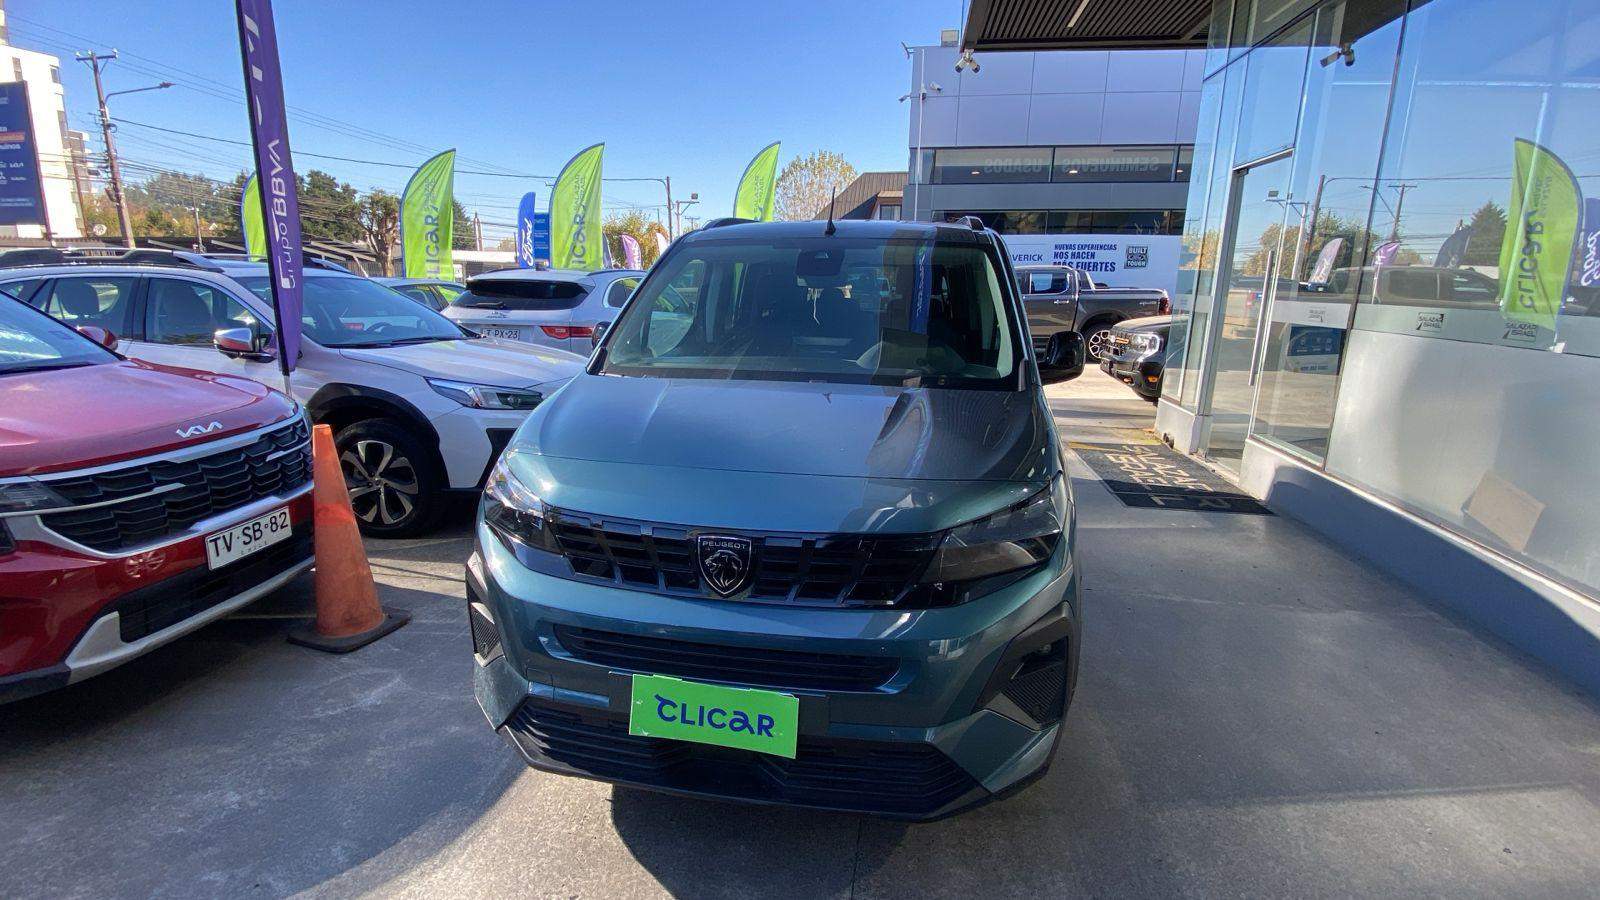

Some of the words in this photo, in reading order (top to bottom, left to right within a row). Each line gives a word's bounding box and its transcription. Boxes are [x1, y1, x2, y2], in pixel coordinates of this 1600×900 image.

[267, 138, 288, 217] BBVA
[1054, 243, 1076, 251] NUEVAS
[1077, 243, 1118, 251] EXPERIENCIAS
[1011, 253, 1043, 262] VERICK
[1053, 251, 1069, 260] NOS
[1070, 251, 1096, 260] HACEN
[1075, 261, 1117, 273] FUERTES
[702, 540, 747, 550] PEUGEOT
